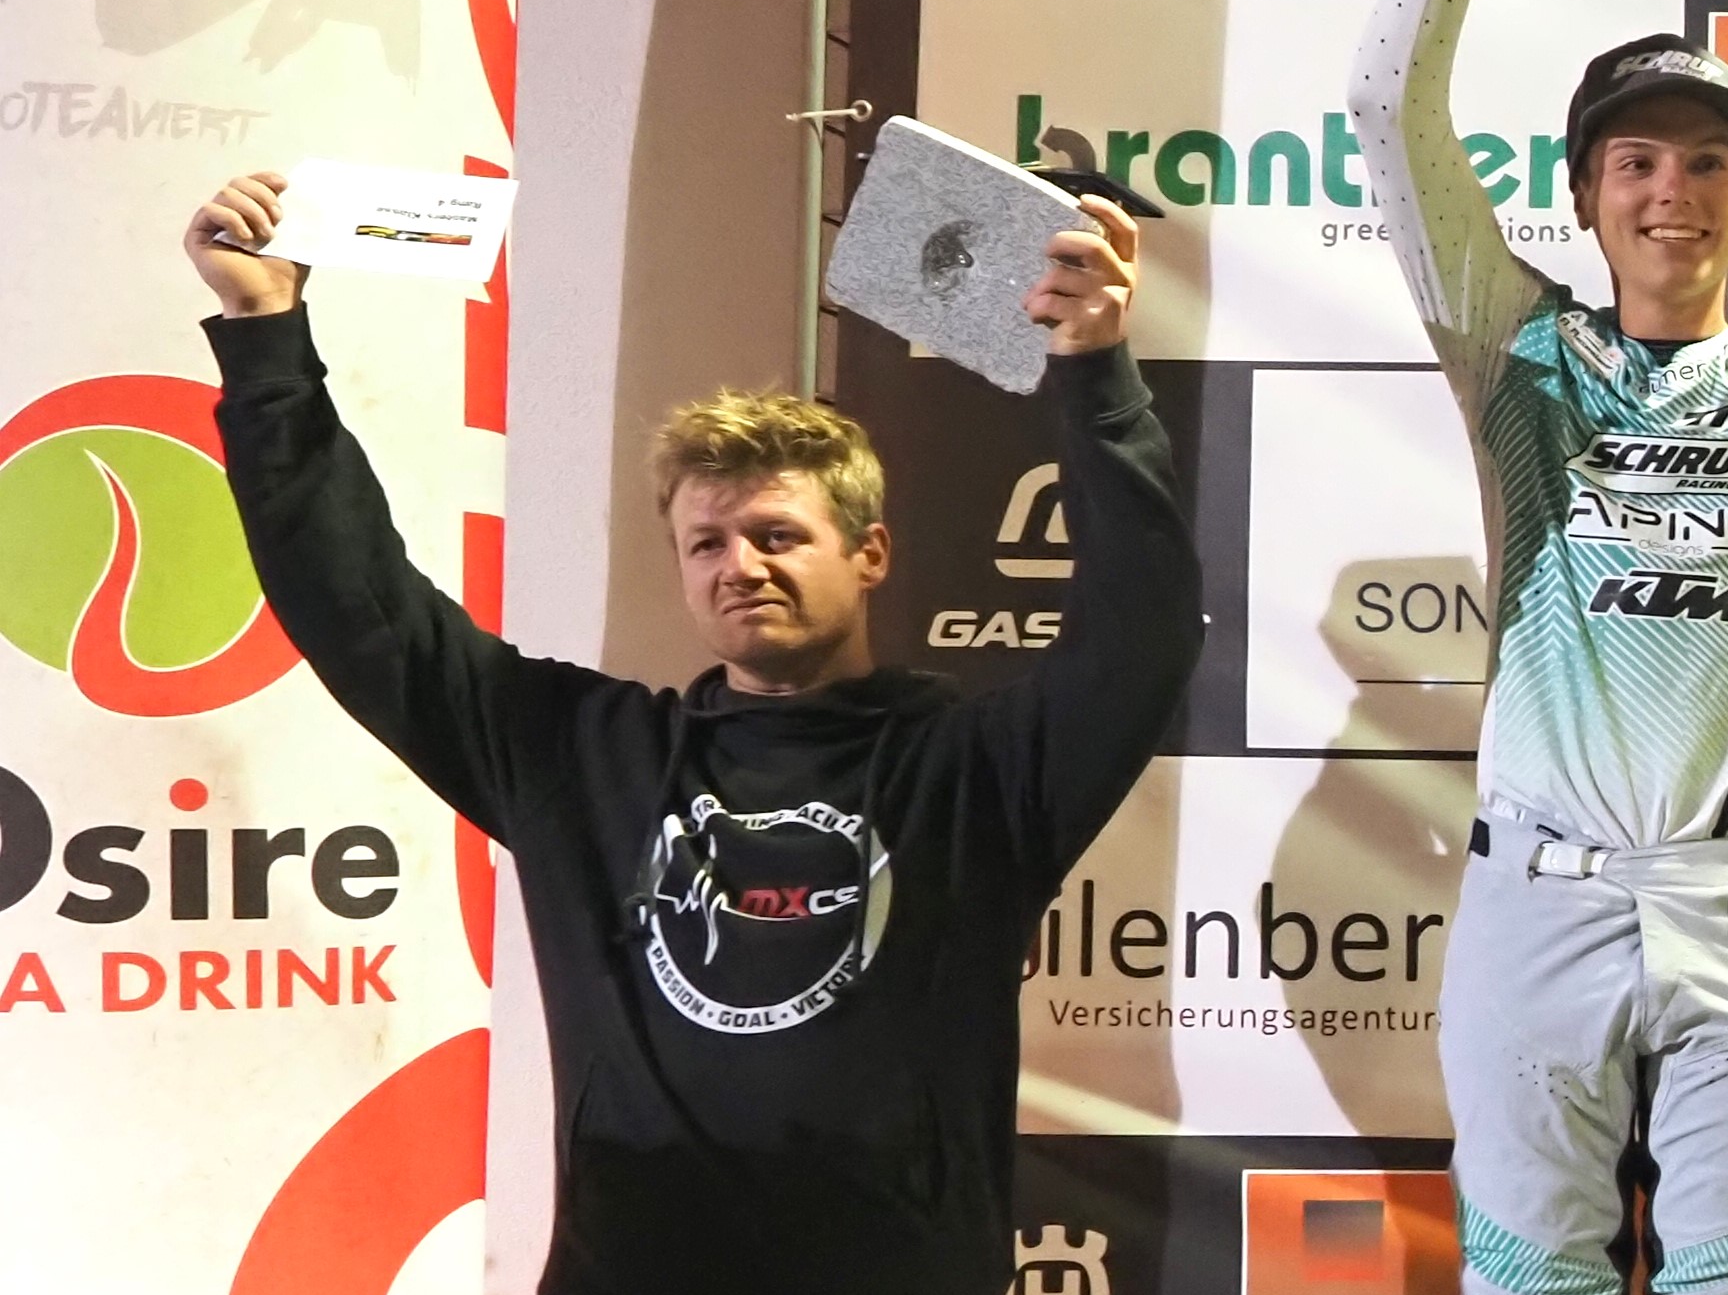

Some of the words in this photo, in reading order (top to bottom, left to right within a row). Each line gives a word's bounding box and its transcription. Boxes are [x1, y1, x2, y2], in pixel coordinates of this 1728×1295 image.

[1320, 222, 1390, 248] gree
[1049, 879, 1443, 982] ilenber
[102, 944, 398, 1013] DRINK
[651, 946, 706, 1016] PASSION
[718, 1010, 775, 1028] GOAL
[791, 955, 852, 1016] VICTO
[1049, 998, 1442, 1037] Versicherungsagentur
